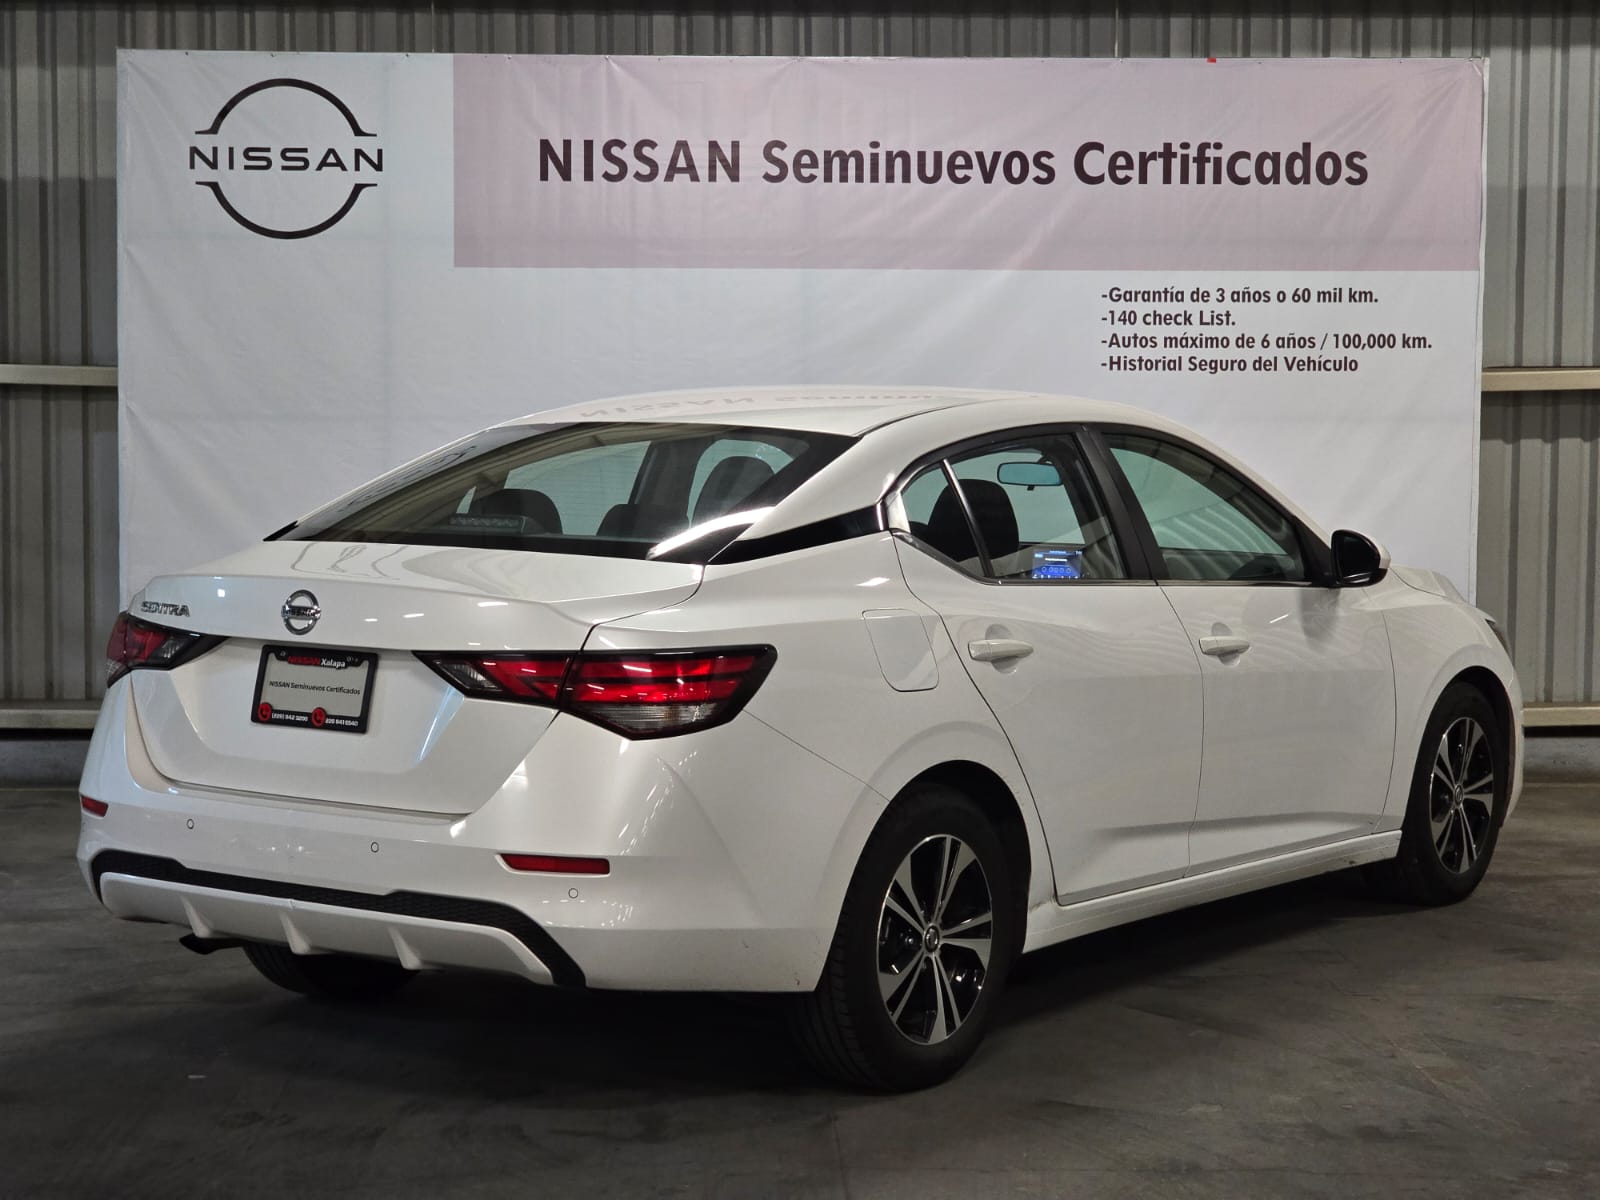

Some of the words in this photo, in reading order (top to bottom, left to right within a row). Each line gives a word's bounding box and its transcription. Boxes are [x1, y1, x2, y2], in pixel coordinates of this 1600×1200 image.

[189, 144, 384, 172] NISSAN
[539, 138, 740, 183] NISSAN
[762, 139, 1056, 186] Seminuevos
[1073, 141, 1369, 186] Certificados
[1101, 286, 1185, 303] -Garantía
[1190, 287, 1211, 303] de
[1216, 287, 1226, 303] 3
[1231, 286, 1272, 303] años
[1277, 290, 1287, 303] o
[1292, 287, 1311, 303] 60
[1316, 287, 1343, 303] mil
[1348, 287, 1379, 303] km.
[1101, 310, 1138, 326] -140
[1142, 310, 1193, 326] check
[1199, 310, 1236, 326] List.
[1101, 333, 1158, 349] -Autos
[1163, 332, 1230, 349] máximo
[1235, 333, 1256, 349] de
[1261, 333, 1271, 349] 6
[1276, 333, 1316, 349] años
[1333, 333, 1397, 351] 100,000
[1402, 333, 1432, 349] km.
[1101, 355, 1183, 372] -Historial
[1188, 355, 1248, 375] Seguro
[1253, 355, 1278, 372] del
[1283, 354, 1359, 372] Vehículo
[140, 600, 190, 617] SENTRA
[269, 681, 290, 689] NISSAN
[290, 682, 325, 692] Seminuevos
[326, 685, 361, 695] Certificados
